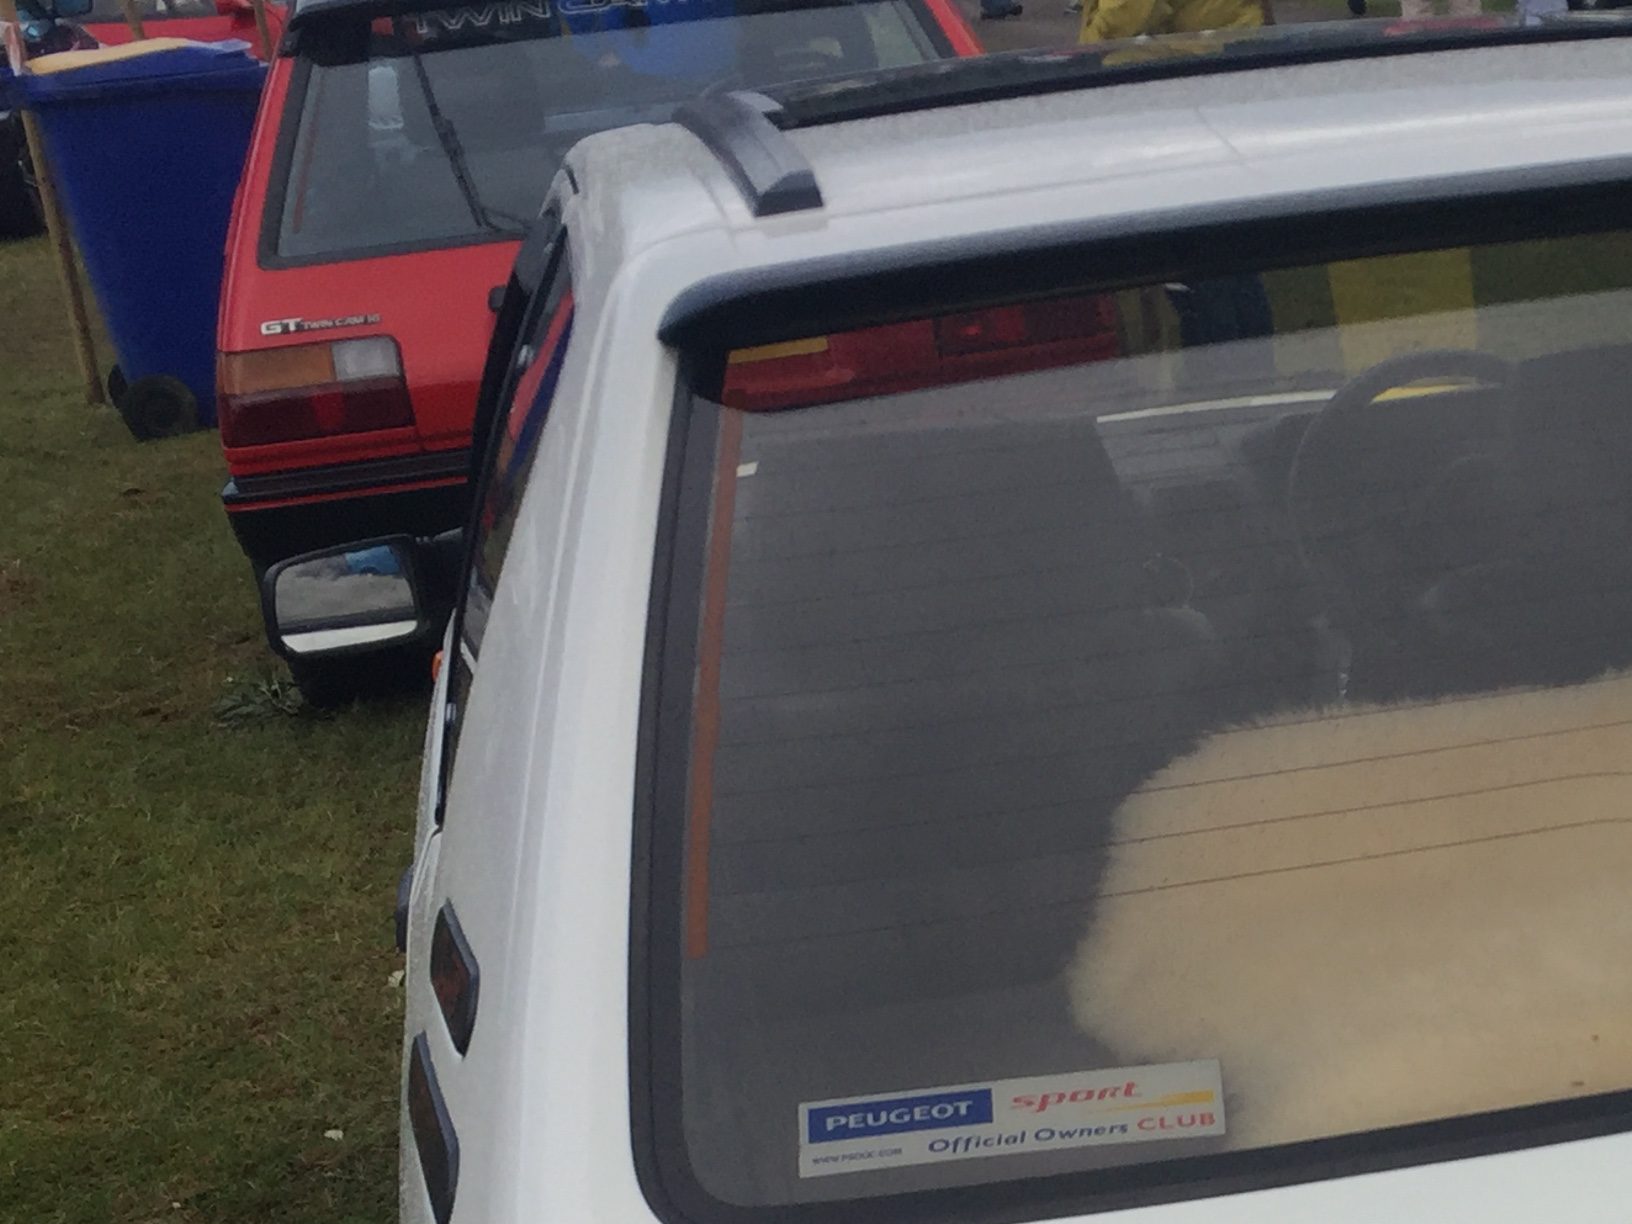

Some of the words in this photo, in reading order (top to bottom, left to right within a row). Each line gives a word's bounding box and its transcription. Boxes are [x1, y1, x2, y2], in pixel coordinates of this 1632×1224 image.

[413, 0, 552, 34] TWIN
[260, 317, 303, 335] GT
[826, 1100, 974, 1132] PEUGEOT
[1010, 1081, 1141, 1113] sport
[928, 1130, 1026, 1154] Official
[1034, 1123, 1129, 1142] Owners
[1137, 1112, 1217, 1132] CLUB
